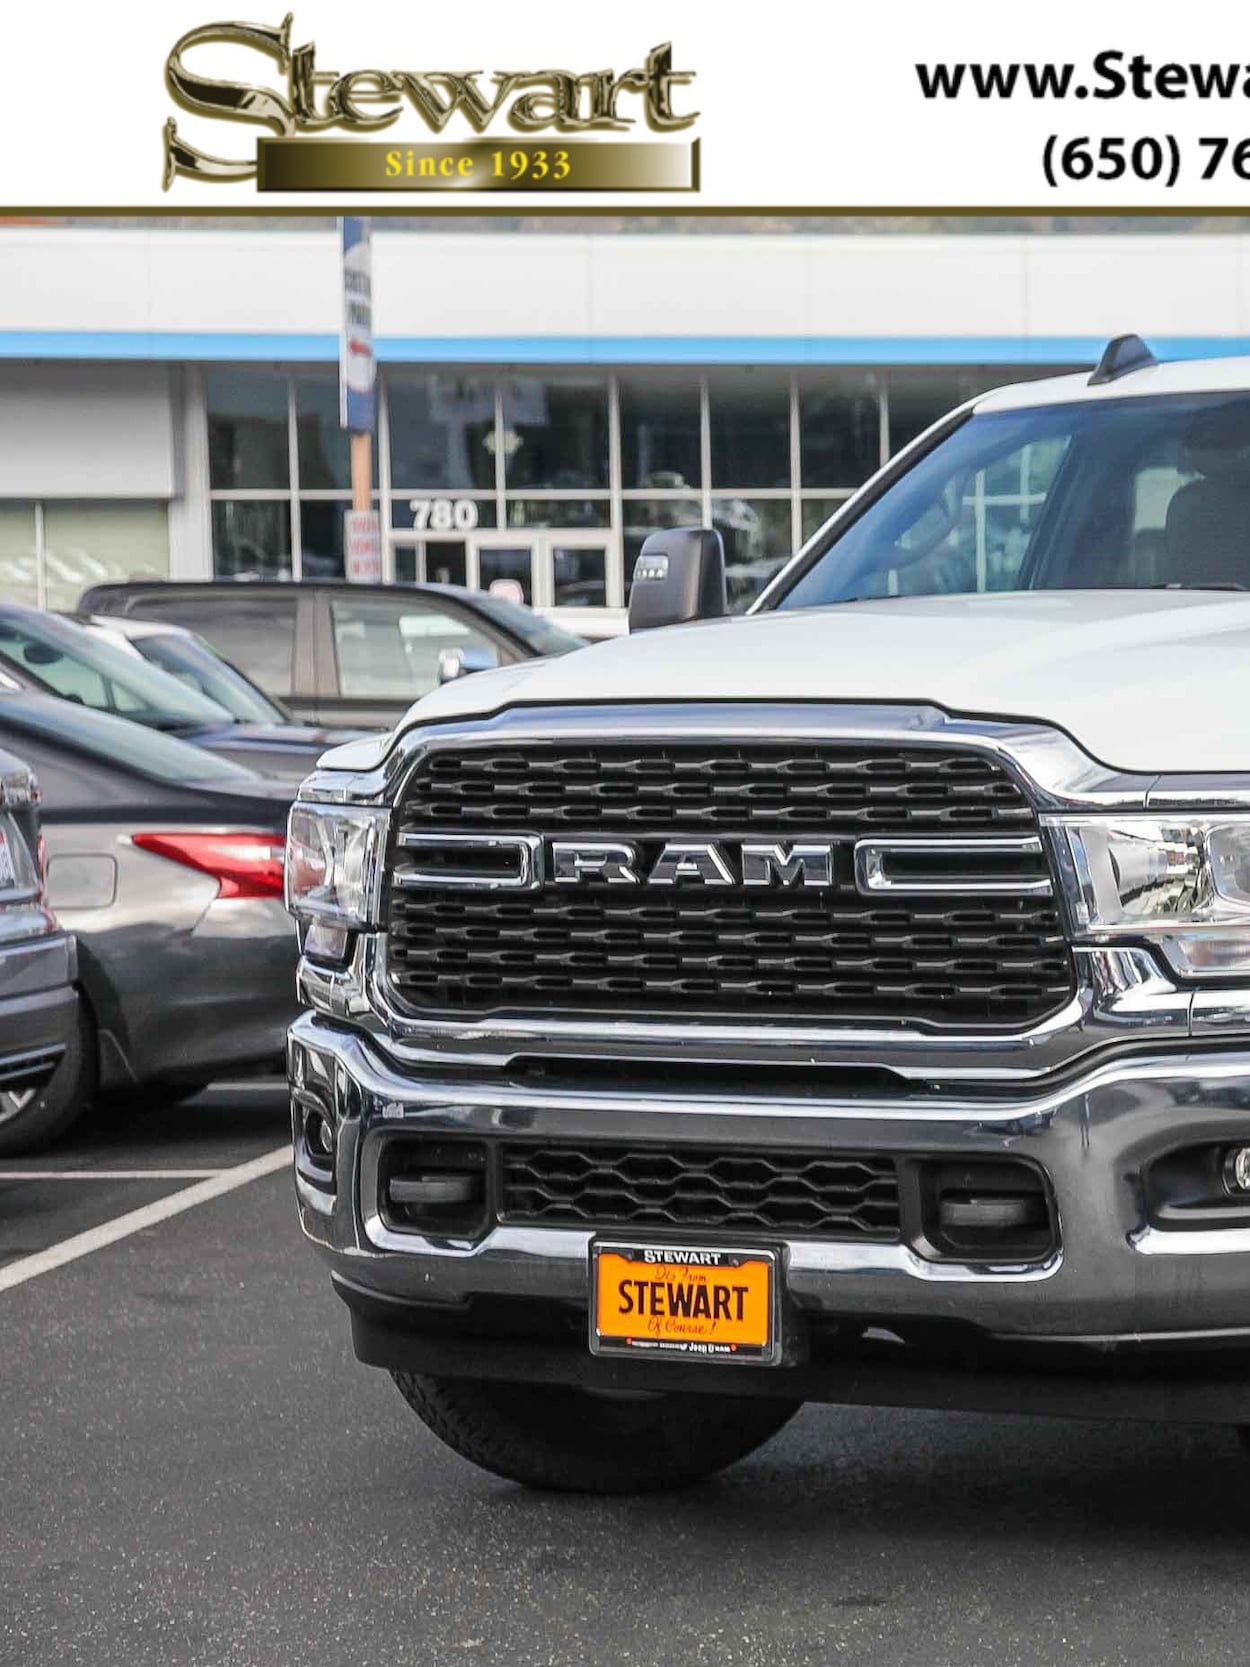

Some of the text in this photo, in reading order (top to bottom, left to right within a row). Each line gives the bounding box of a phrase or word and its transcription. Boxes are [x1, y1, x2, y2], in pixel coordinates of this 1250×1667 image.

[409, 499, 479, 530] 780
[551, 840, 834, 886] RAM
[644, 1249, 721, 1265] STEWART
[618, 1279, 749, 1322] STEWART
